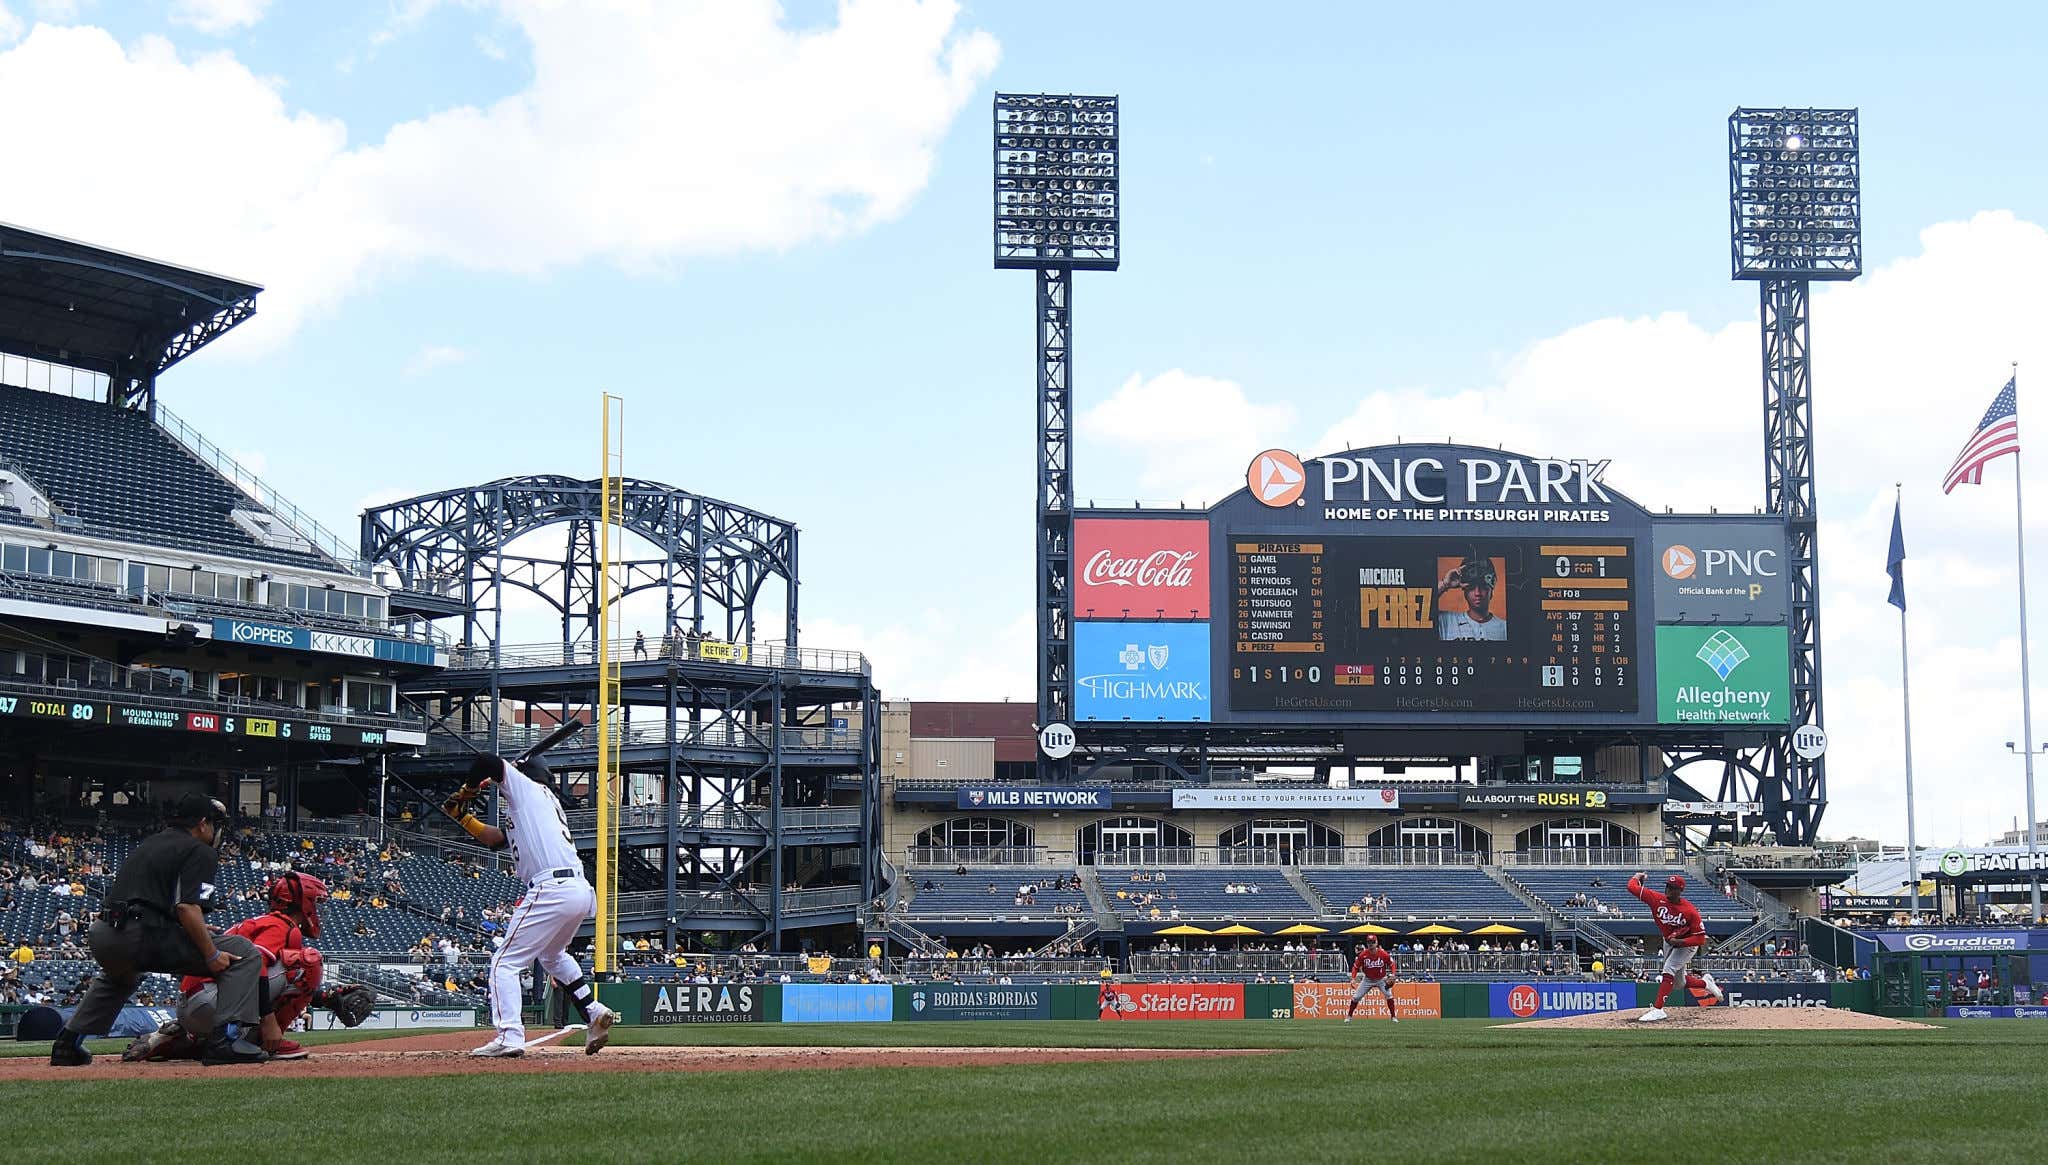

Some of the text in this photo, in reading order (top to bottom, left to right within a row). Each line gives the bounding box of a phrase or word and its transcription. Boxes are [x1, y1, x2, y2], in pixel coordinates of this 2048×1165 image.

[1317, 457, 1612, 504] PNC PARK
[1325, 508, 1610, 522] HOME OF THE PITTSBURGH PIRATES
[1258, 544, 1301, 553] PIRATES
[1250, 555, 1277, 563] GAMEL
[1701, 550, 1776, 576] PNC
[1084, 550, 1200, 587] Coca-Cola
[1250, 566, 1276, 574] HAYES
[1556, 556, 1605, 577] 0 FOR 1
[1251, 577, 1291, 585] REYNOLDS
[1360, 568, 1405, 585] MICHAEL
[1251, 588, 1298, 596] VOGELBACH
[1548, 590, 1561, 598] 3rd
[1679, 587, 1746, 595] Official Bank of the
[1360, 587, 1433, 628] PEREZ
[1251, 610, 1293, 618] VANMETER
[232, 621, 293, 645] KOPPERS
[1252, 632, 1283, 640] CASTRO
[1594, 634, 1604, 642] HR
[1614, 634, 1620, 642] 2
[705, 645, 741, 657] RETIRE 21
[1250, 666, 1256, 682] 1
[1264, 669, 1272, 679] S
[1280, 666, 1287, 682] 1
[1308, 666, 1320, 682] 0
[1347, 666, 1623, 676] CIN 0 0 0 0 0 0 0 3 0 2
[1384, 676, 1390, 684] 0
[1400, 676, 1406, 684] 0
[1416, 676, 1422, 684] 0
[1437, 676, 1443, 684] 0
[1452, 676, 1458, 684] 0
[1550, 677, 1556, 685] 0
[1572, 677, 1578, 685] 0
[1595, 677, 1601, 685] 0
[1618, 677, 1624, 686] 2
[1275, 696, 1352, 707] HeGetsUs.com
[1676, 686, 1771, 708] Allegheny
[30, 702, 66, 716] TOTAL
[72, 704, 93, 720] 80
[122, 709, 179, 721] MOUND VISITS
[1676, 709, 1770, 720] Health Network
[128, 717, 173, 728] REMAINING
[192, 716, 291, 738] CIN 5 PIT 5
[310, 726, 331, 734] PITCH
[310, 733, 332, 741] SPEED
[362, 732, 383, 744] MPH
[1044, 732, 1072, 749] Lite
[1796, 733, 1824, 750] Lite
[988, 792, 1098, 804] MLB NETWORK
[1466, 793, 1580, 805] ALL ABOUT THE RUSH
[1657, 906, 1686, 925] Reds
[1906, 934, 2015, 950] Guardian
[1364, 958, 1384, 968] Reds
[654, 986, 752, 1012] AERAS
[934, 992, 982, 1006] BORDAS
[989, 992, 1038, 1005] BORDAS
[1512, 992, 1535, 1010] 84
[1542, 992, 1618, 1010] LUMBER
[653, 1014, 752, 1023] DRONE TECHNOLOGIES
[1272, 1009, 1290, 1018] 379
